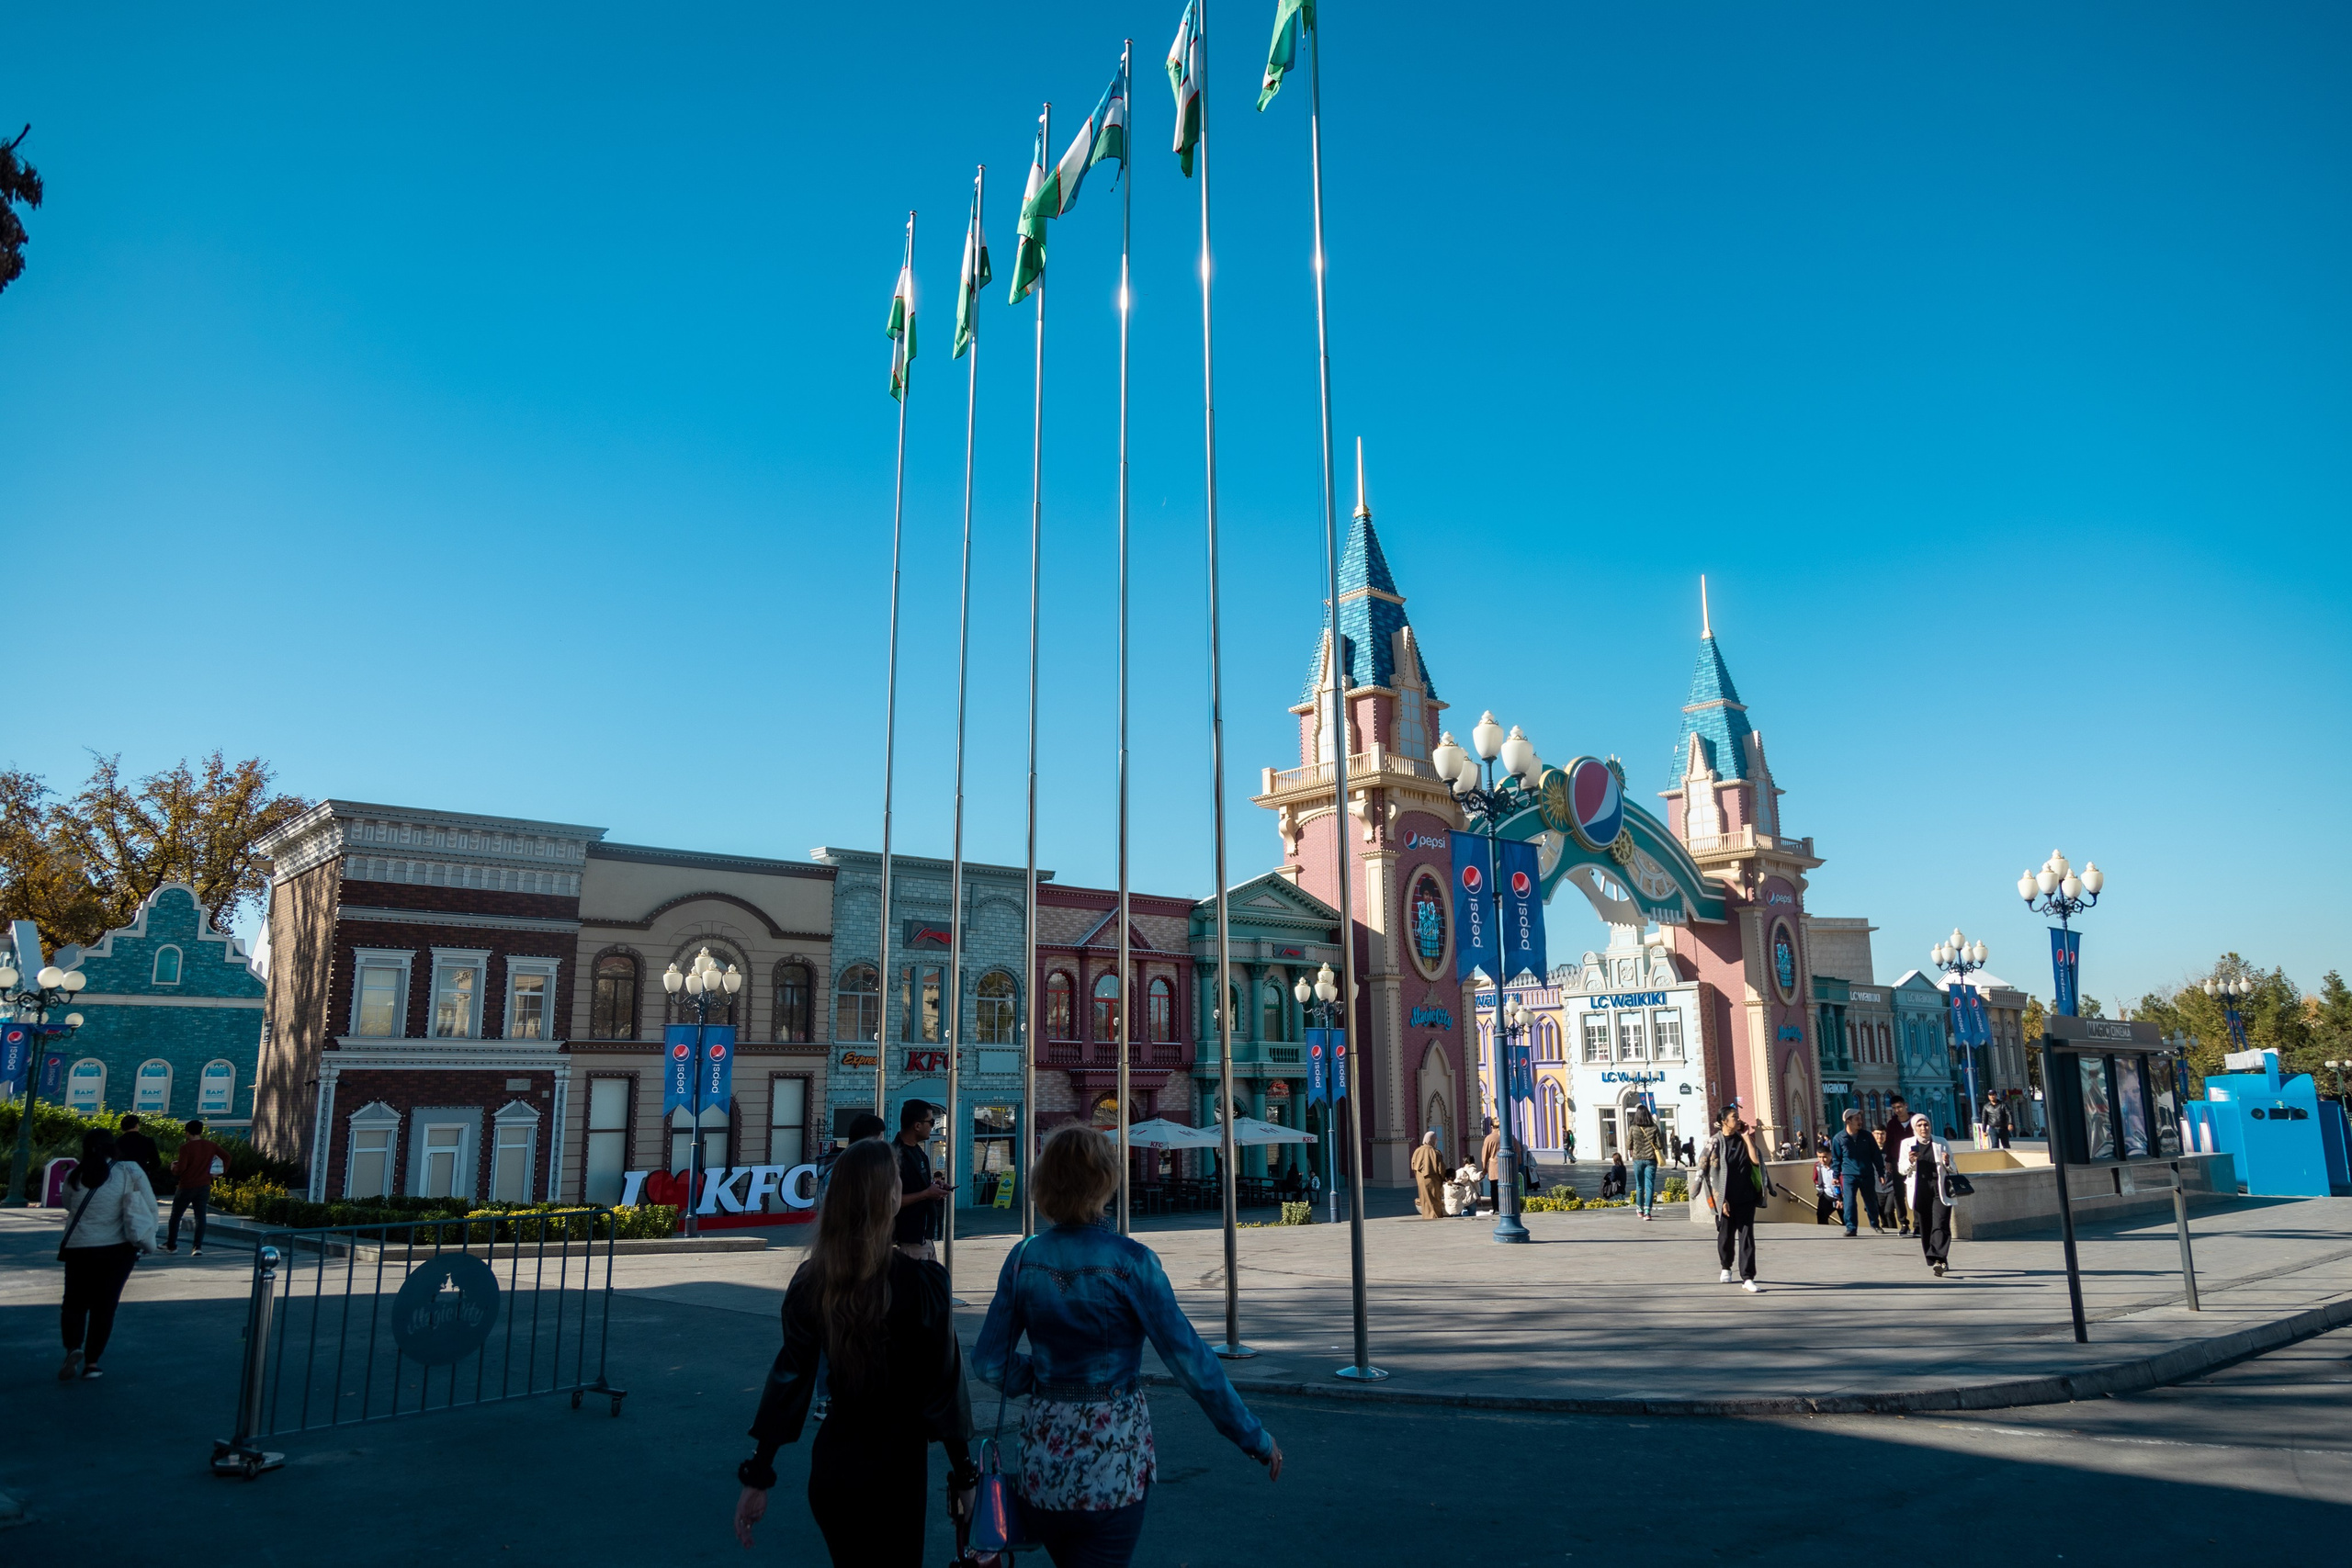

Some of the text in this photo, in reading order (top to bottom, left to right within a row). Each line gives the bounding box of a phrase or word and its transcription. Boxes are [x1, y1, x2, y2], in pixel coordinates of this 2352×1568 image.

[1419, 835, 1445, 850] pepsi
[1776, 894, 1792, 904] pepsi
[1467, 897, 1483, 948] pepsi
[1516, 903, 1532, 951] pepsi
[1590, 996, 1609, 1009] LC
[1956, 1010, 1965, 1033] pepsi
[2088, 1023, 2132, 1037] MAGIC CINEMA
[7, 1046, 18, 1070] pepsi
[842, 1051, 878, 1068] Expres
[906, 1051, 963, 1071] KFC
[675, 1064, 687, 1094] pepsi
[710, 1064, 721, 1094] pepsi
[1314, 1062, 1322, 1088] pepsi
[1601, 1071, 1617, 1083] LC
[619, 1162, 818, 1215] I KFC
